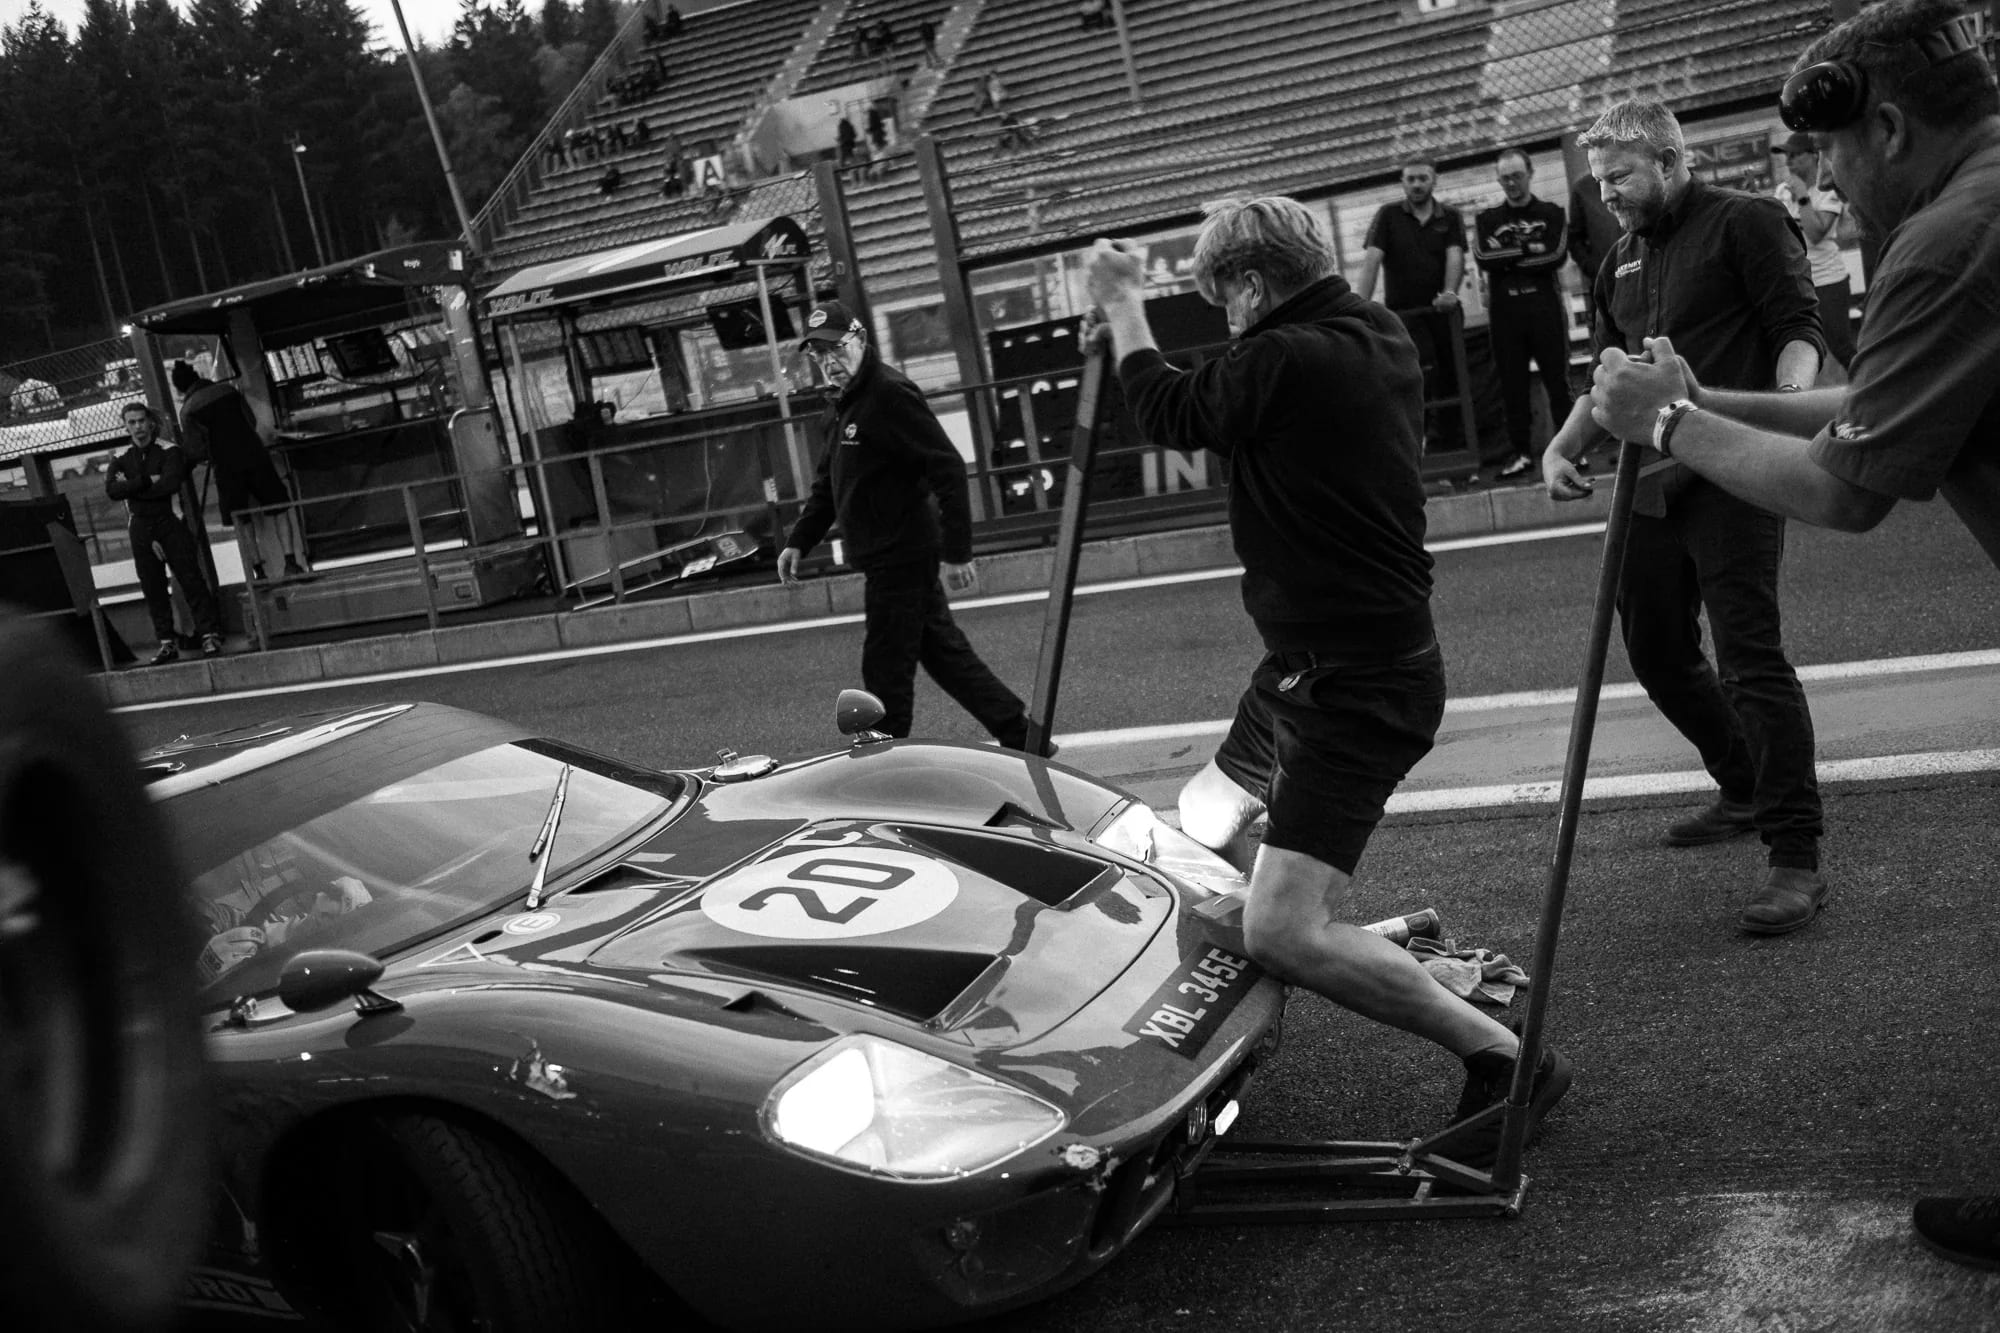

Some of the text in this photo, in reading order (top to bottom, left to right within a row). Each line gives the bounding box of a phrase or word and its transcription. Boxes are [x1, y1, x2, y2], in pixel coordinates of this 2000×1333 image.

[703, 159, 721, 186] A
[1142, 448, 1209, 497] IN
[738, 858, 916, 925] 20
[1138, 947, 1250, 1049] XBL 345E
